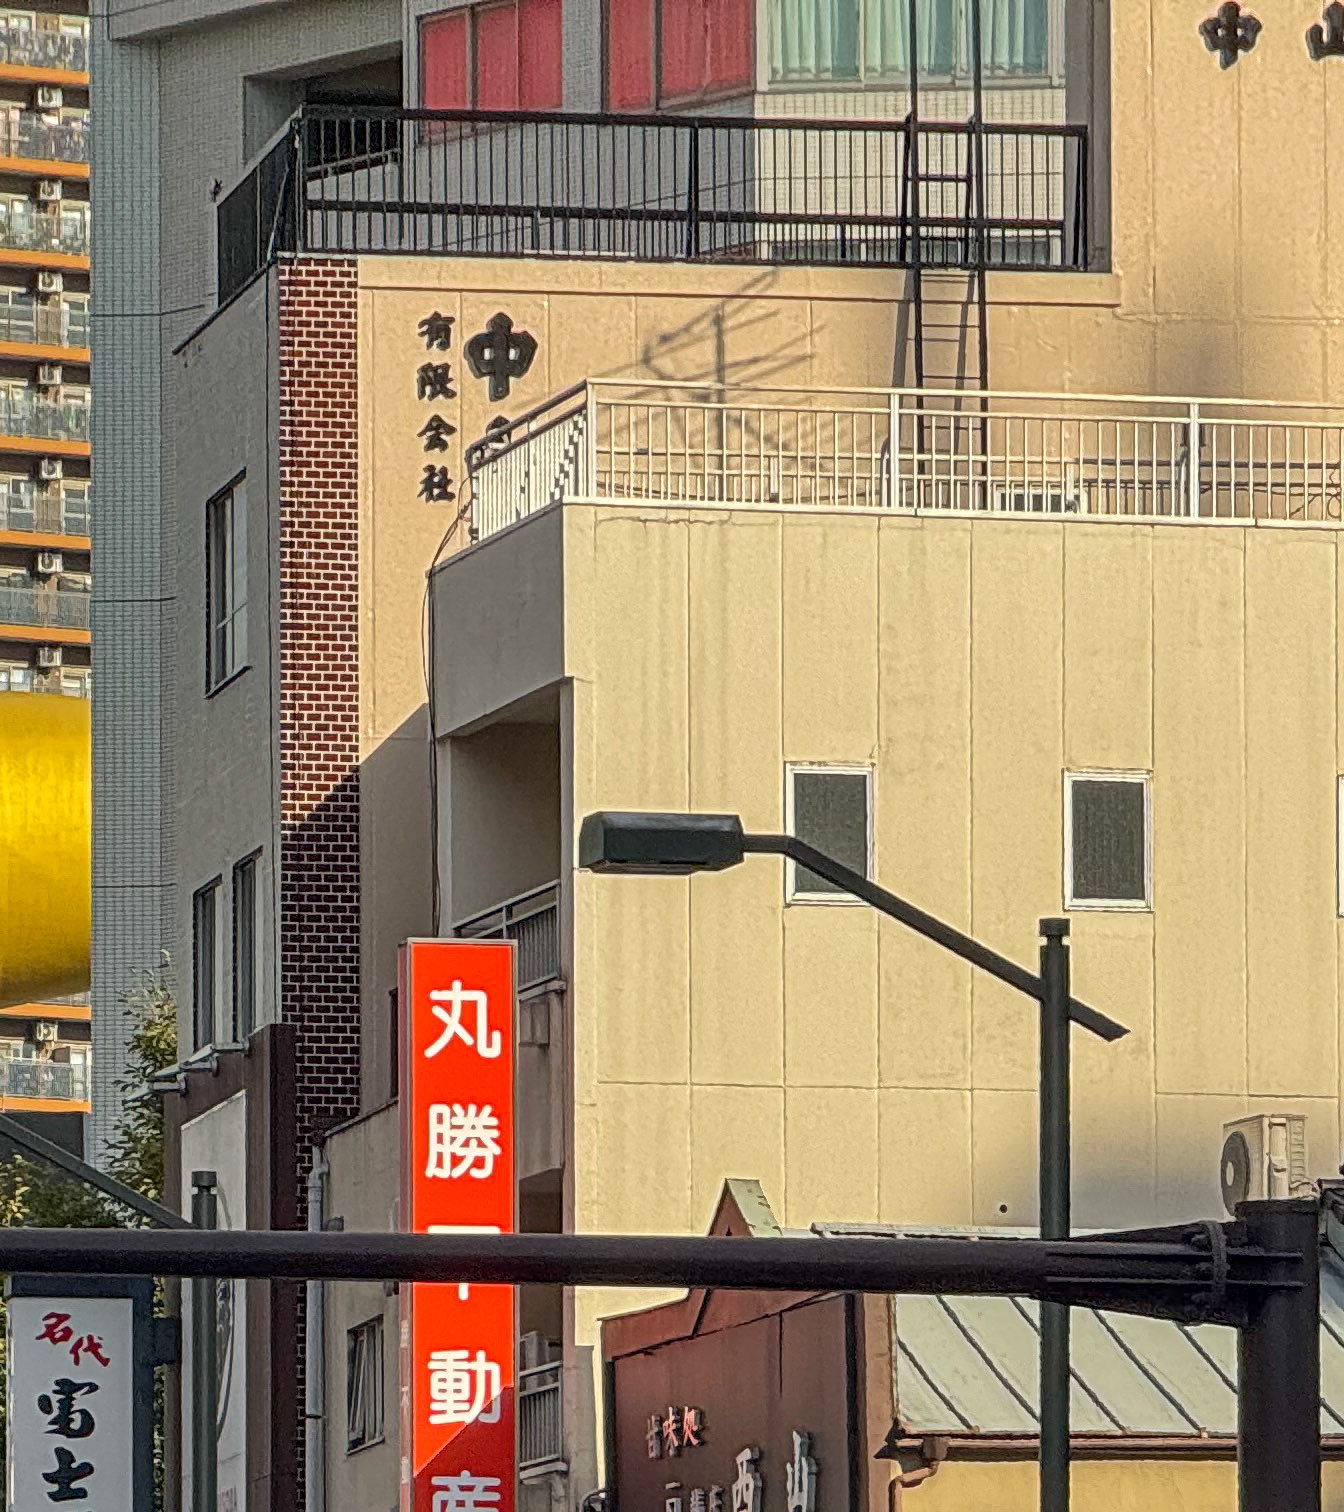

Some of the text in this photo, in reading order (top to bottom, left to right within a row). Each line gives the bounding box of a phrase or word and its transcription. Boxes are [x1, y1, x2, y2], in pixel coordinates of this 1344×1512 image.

[417, 310, 457, 503] 有限会社
[35, 1311, 111, 1367] 名代
